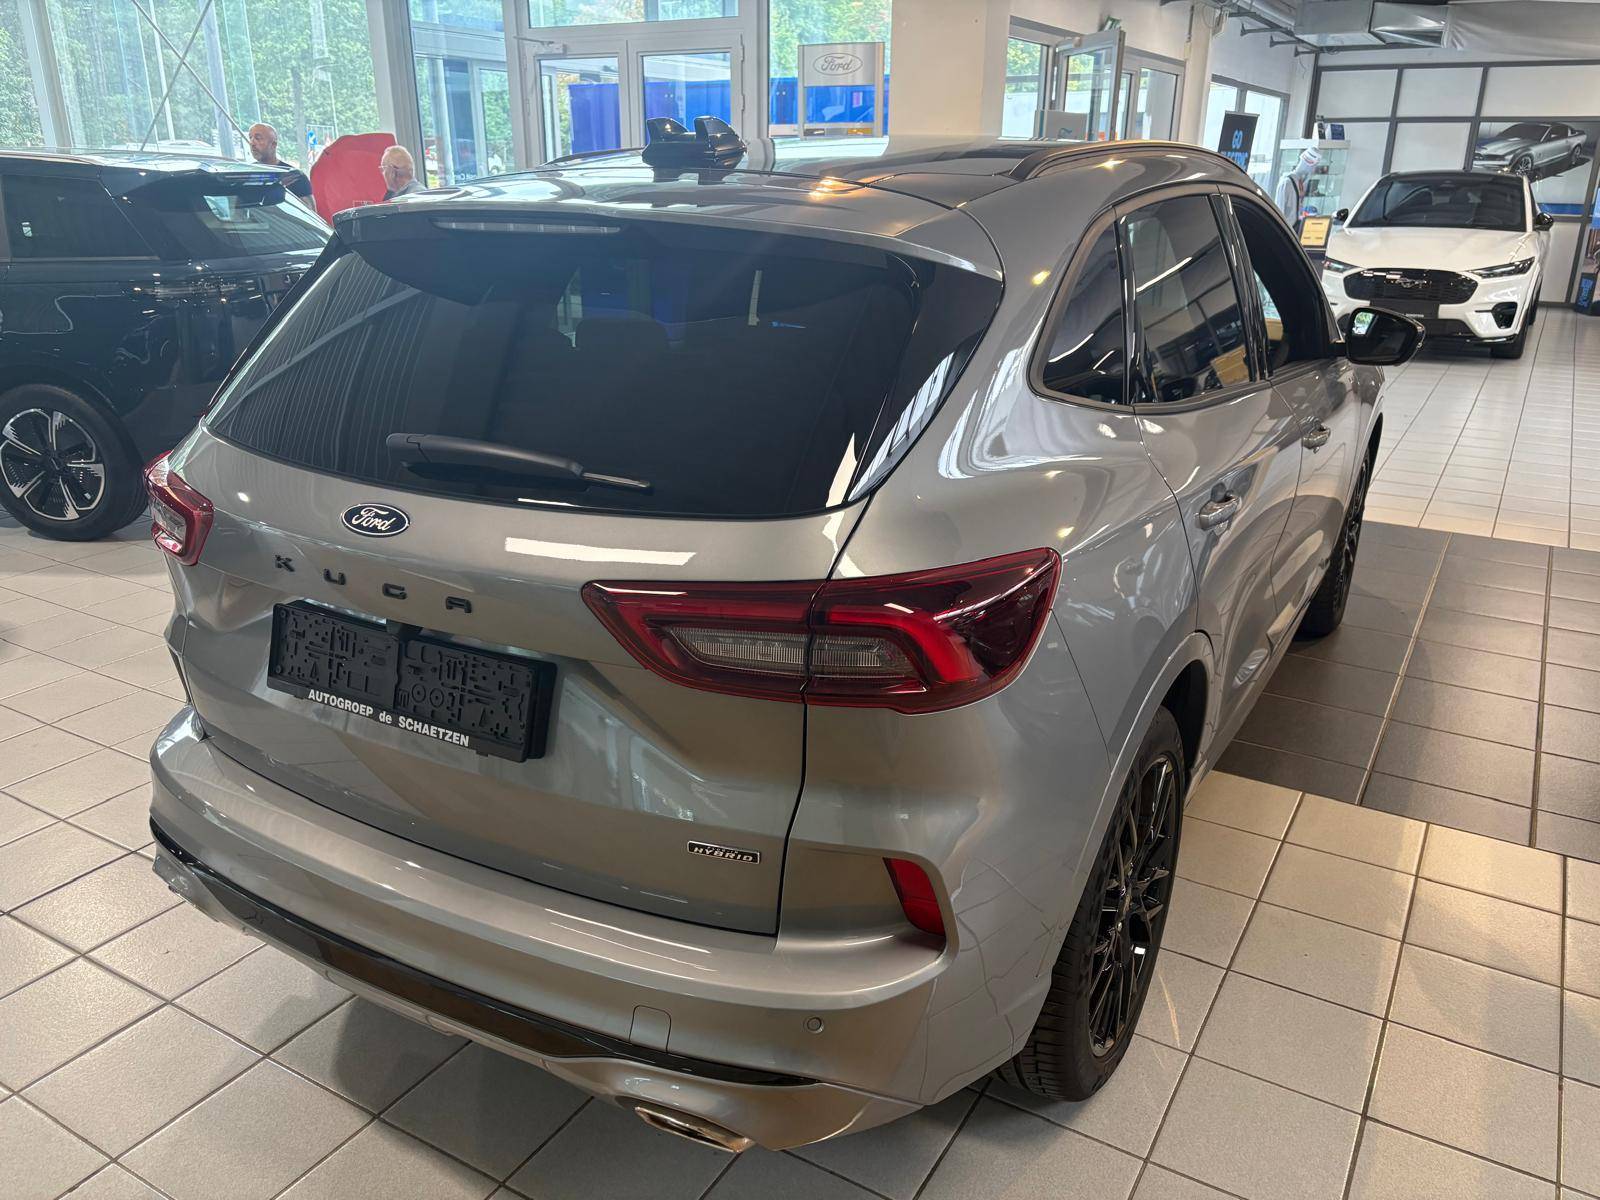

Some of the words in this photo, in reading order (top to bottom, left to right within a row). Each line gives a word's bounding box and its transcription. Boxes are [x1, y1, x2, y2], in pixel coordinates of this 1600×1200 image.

[820, 55, 854, 72] Ford
[351, 507, 396, 532] Ford
[274, 554, 473, 615] KUGA
[308, 688, 374, 718] AUTOGROEP
[378, 710, 393, 725] de
[398, 715, 470, 747] SCHAETZEN
[692, 846, 754, 862] HYBRID
